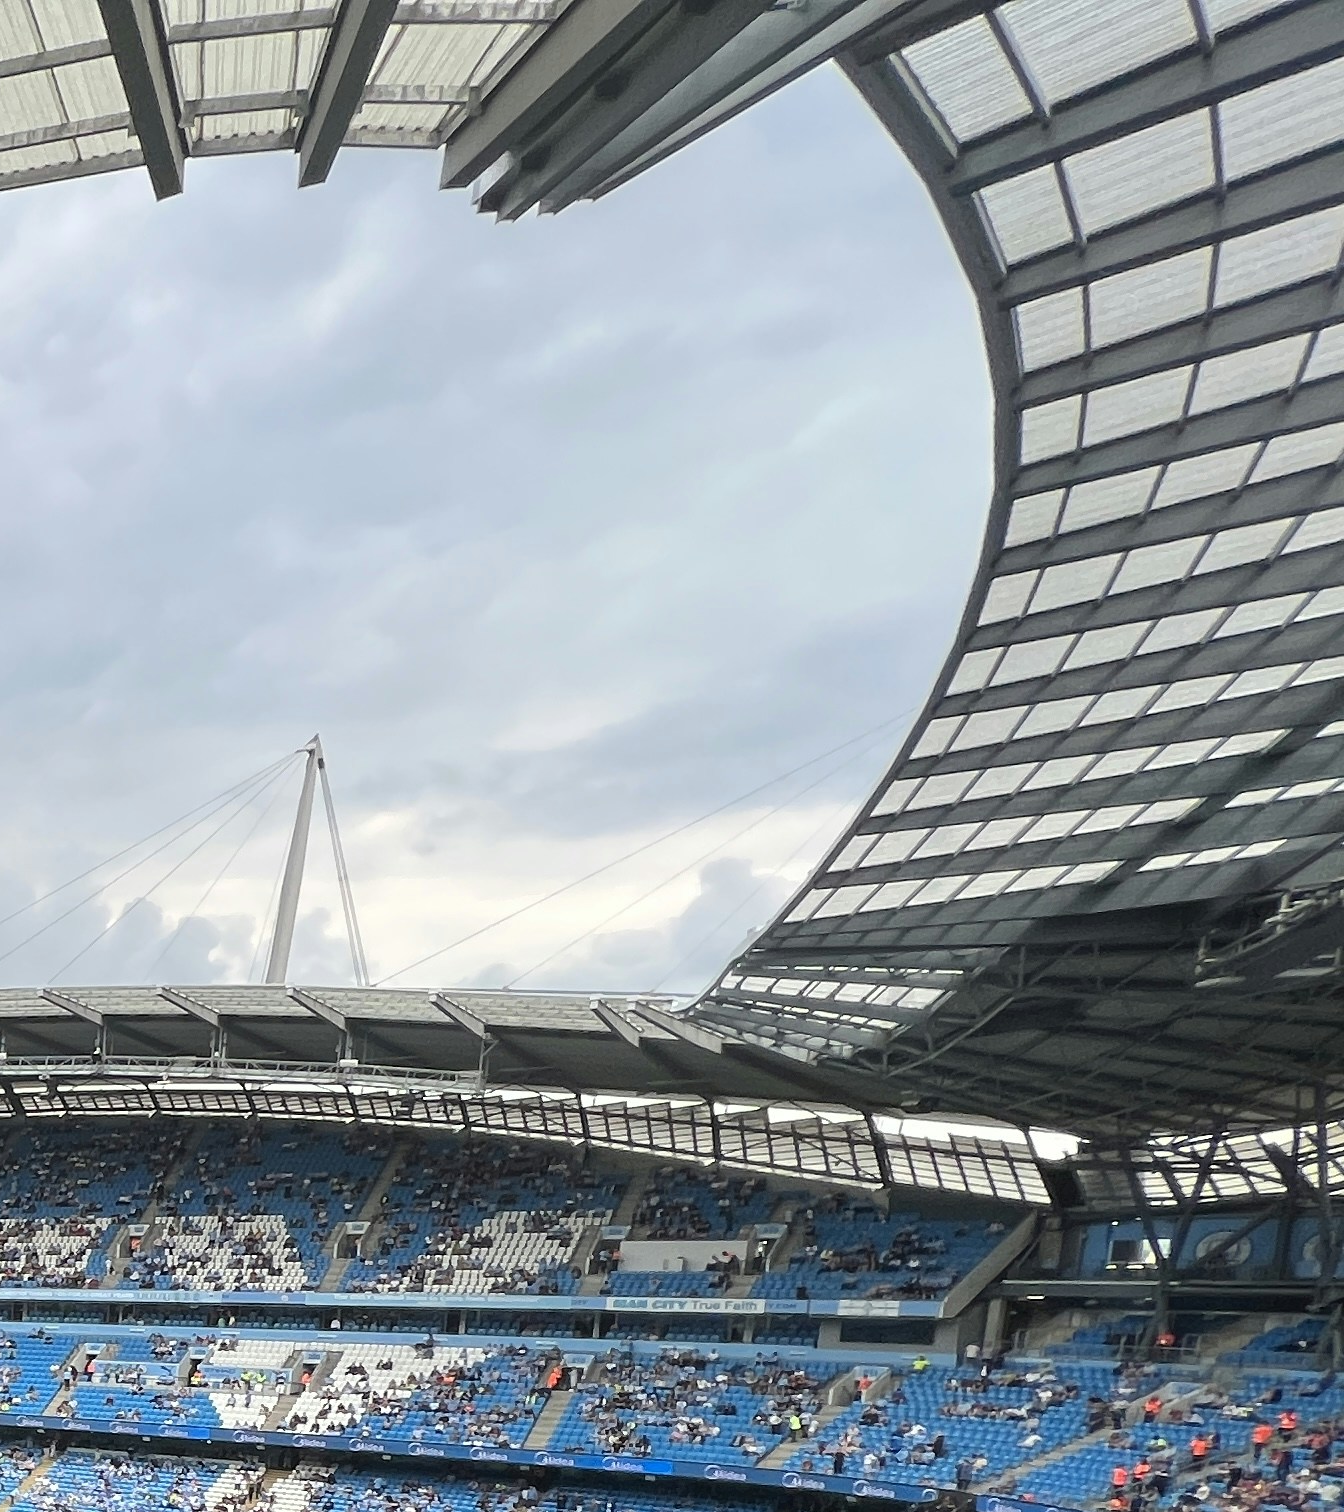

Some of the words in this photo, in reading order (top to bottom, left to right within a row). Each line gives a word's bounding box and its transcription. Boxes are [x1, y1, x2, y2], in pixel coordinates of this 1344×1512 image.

[652, 1300, 688, 1310] CITY
[692, 1300, 720, 1310] True
[724, 1301, 758, 1311] Faith
